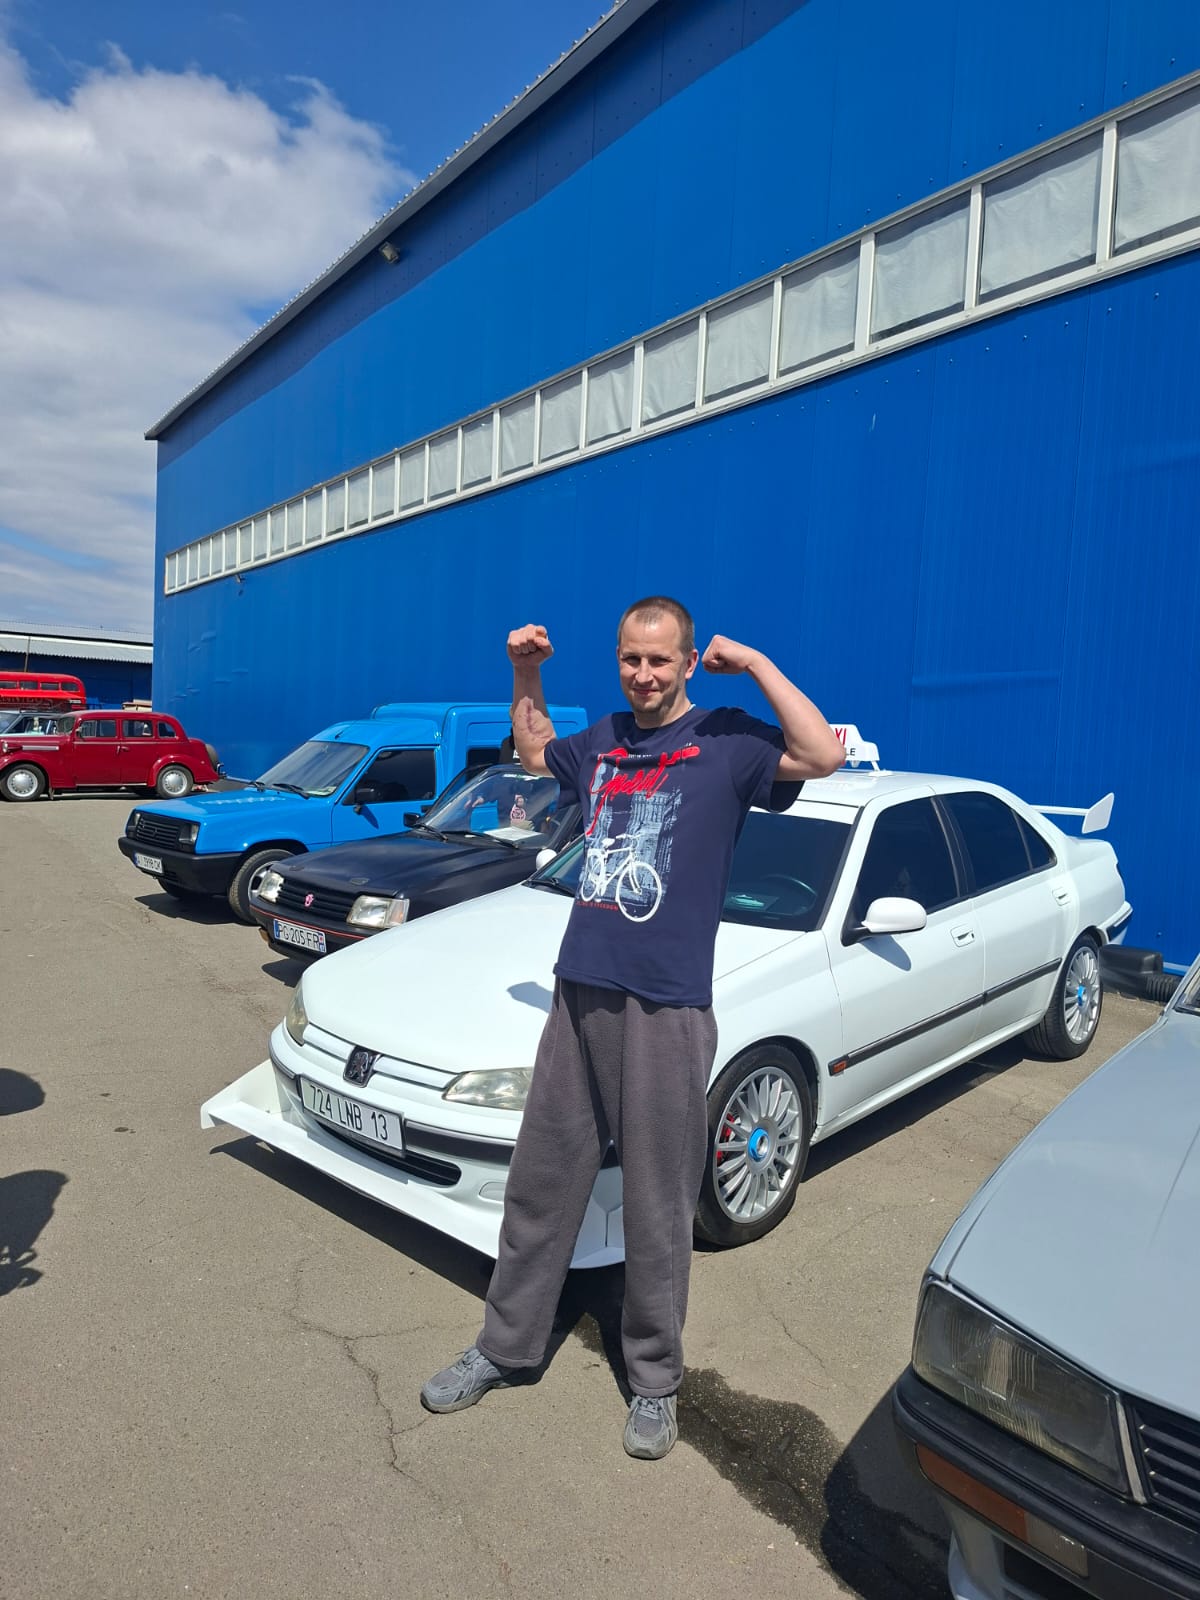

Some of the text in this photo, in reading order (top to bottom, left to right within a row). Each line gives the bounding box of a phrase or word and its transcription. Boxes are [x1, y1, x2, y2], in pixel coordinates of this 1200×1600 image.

[834, 727, 847, 746] XI
[279, 923, 320, 949] PG 205 FR
[310, 1084, 388, 1140] 724 LNB 13
